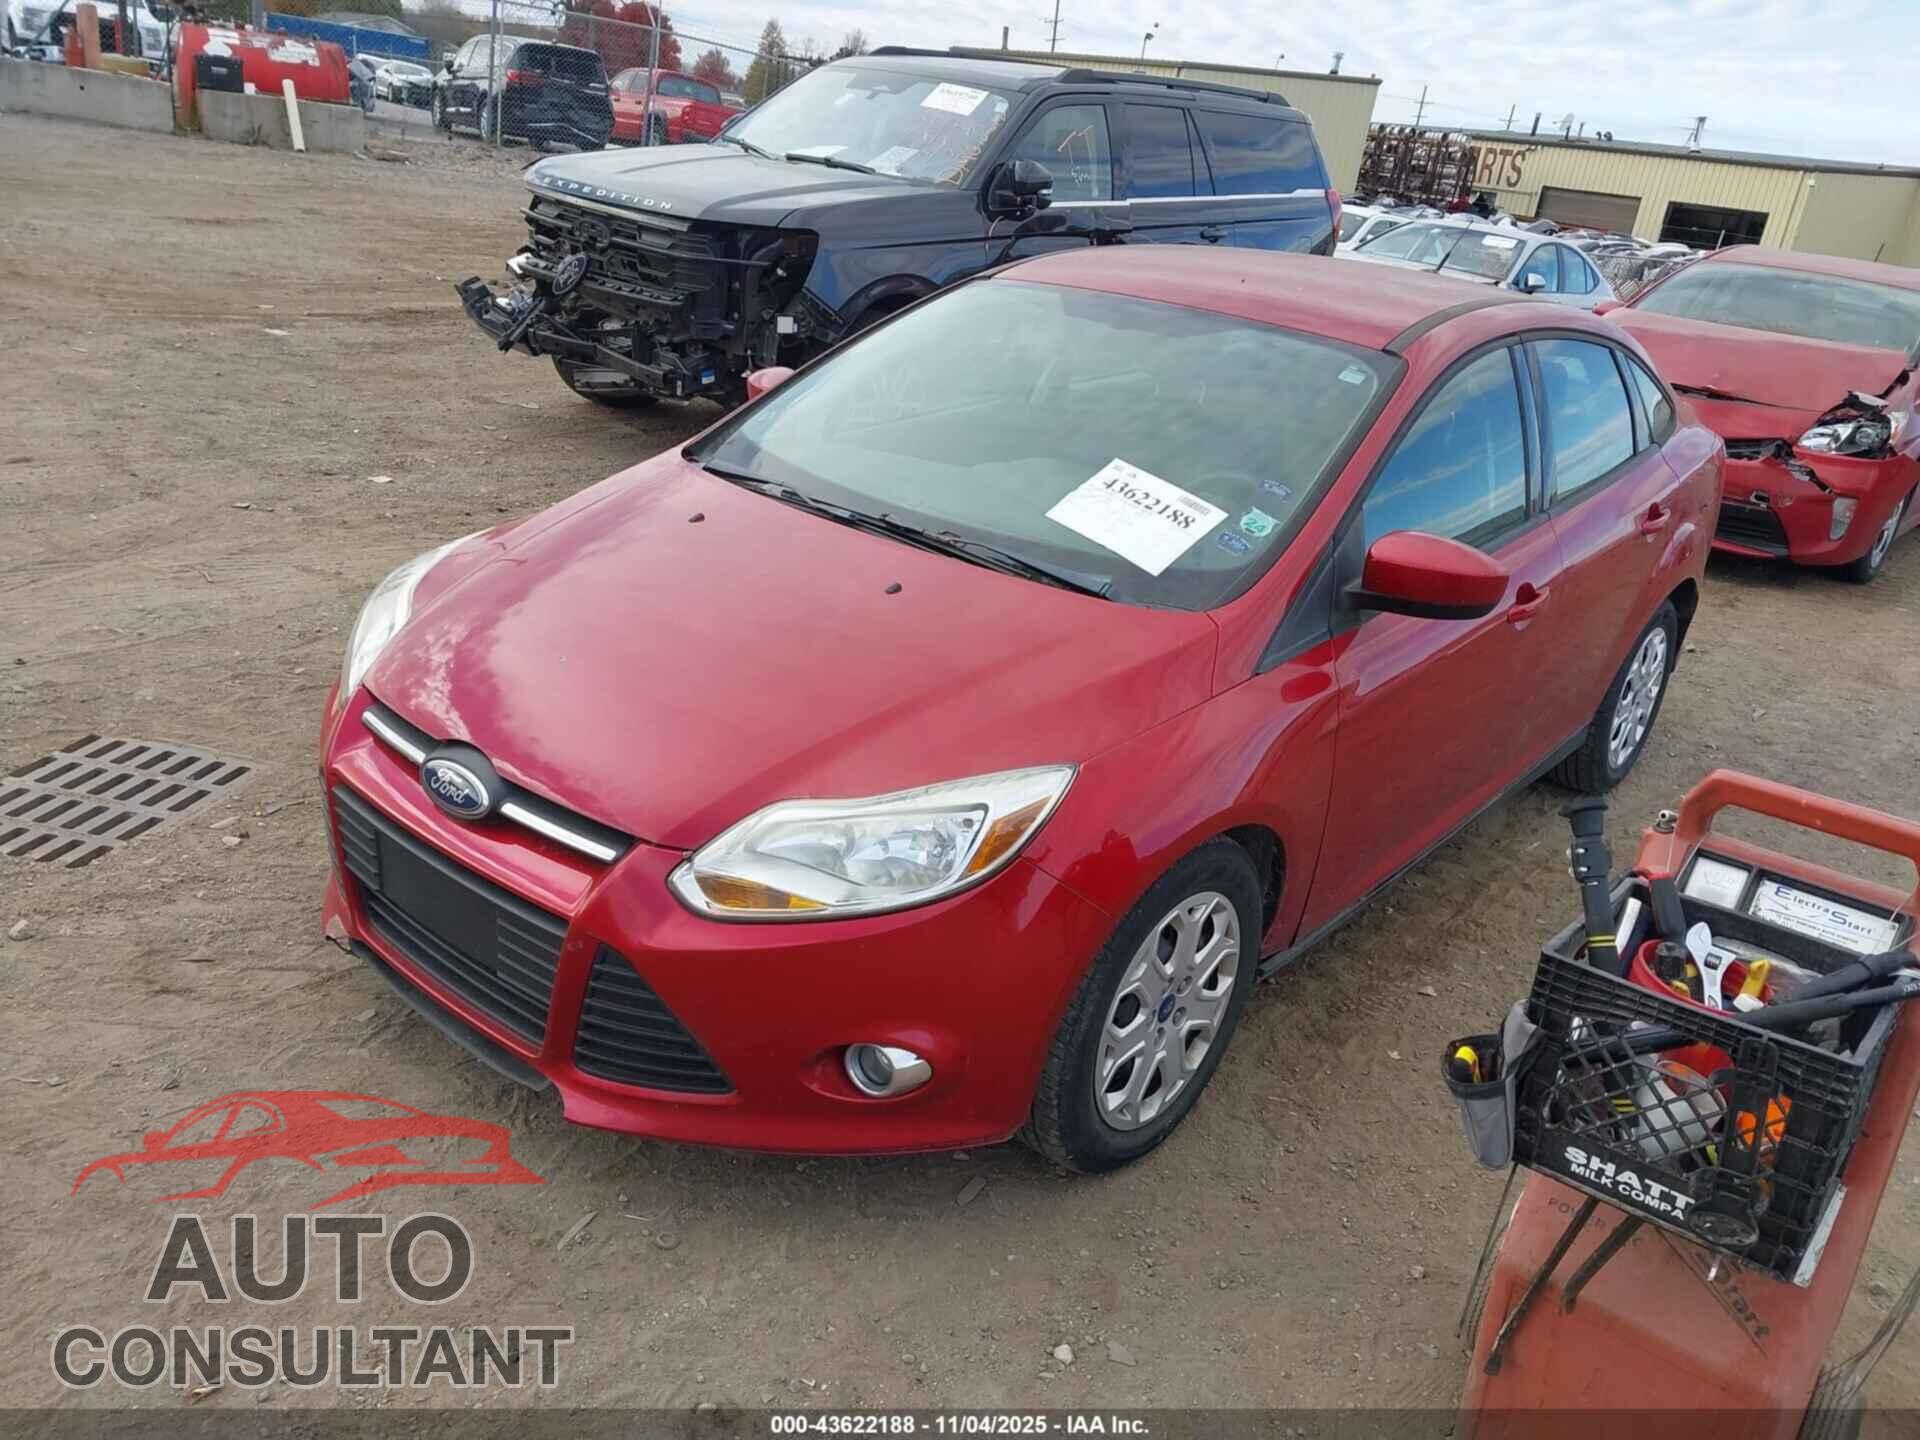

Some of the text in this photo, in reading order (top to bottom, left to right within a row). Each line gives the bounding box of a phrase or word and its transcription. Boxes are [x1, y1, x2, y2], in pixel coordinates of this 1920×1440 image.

[543, 176, 673, 210] EXPEDITION
[1102, 479, 1196, 529] 43622188
[430, 768, 470, 804] Ford
[1564, 1146, 1695, 1210] SHATT
[1570, 1163, 1686, 1221] MILK COMPA
